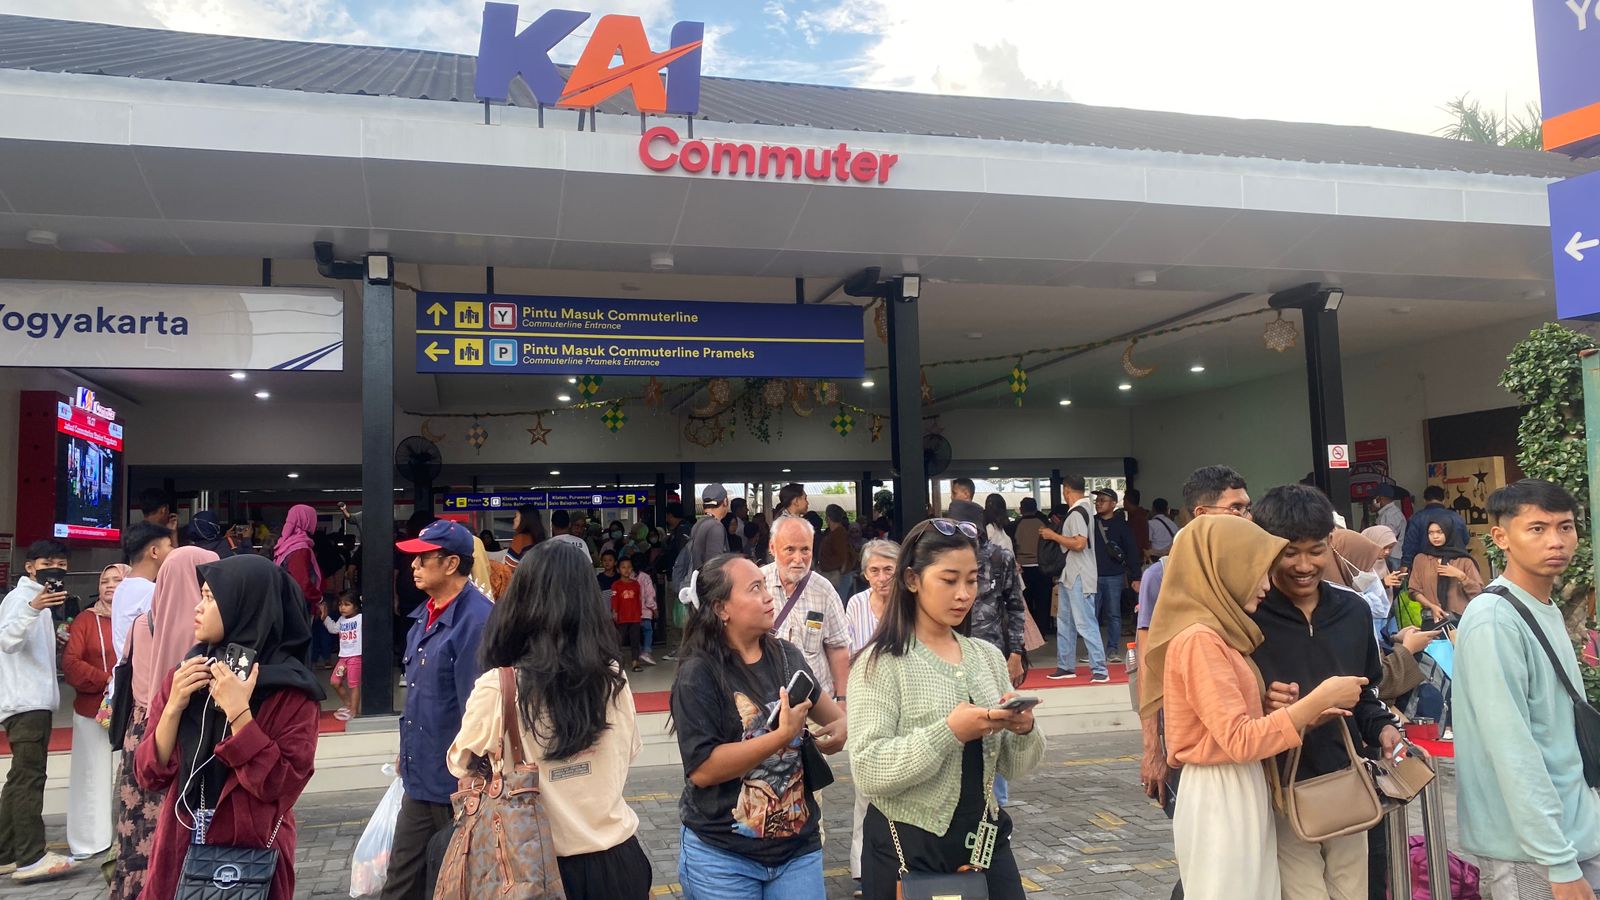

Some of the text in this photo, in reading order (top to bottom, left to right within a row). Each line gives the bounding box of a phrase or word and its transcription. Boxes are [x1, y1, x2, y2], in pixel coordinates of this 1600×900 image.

[475, 2, 705, 115] KAI
[638, 126, 899, 184] Commuter
[498, 310, 508, 322] Y
[522, 306, 699, 322] Pintu Masuk Commuterline
[0, 304, 188, 339] ogyakarta
[522, 319, 622, 330] Commuterline Entrance
[499, 347, 508, 358] P
[523, 343, 755, 359] Pintu Masuk Commuterline Prameks
[522, 356, 660, 367] Commuterline Prameks Entrance
[482, 497, 489, 507] 3
[617, 495, 624, 504] 3
